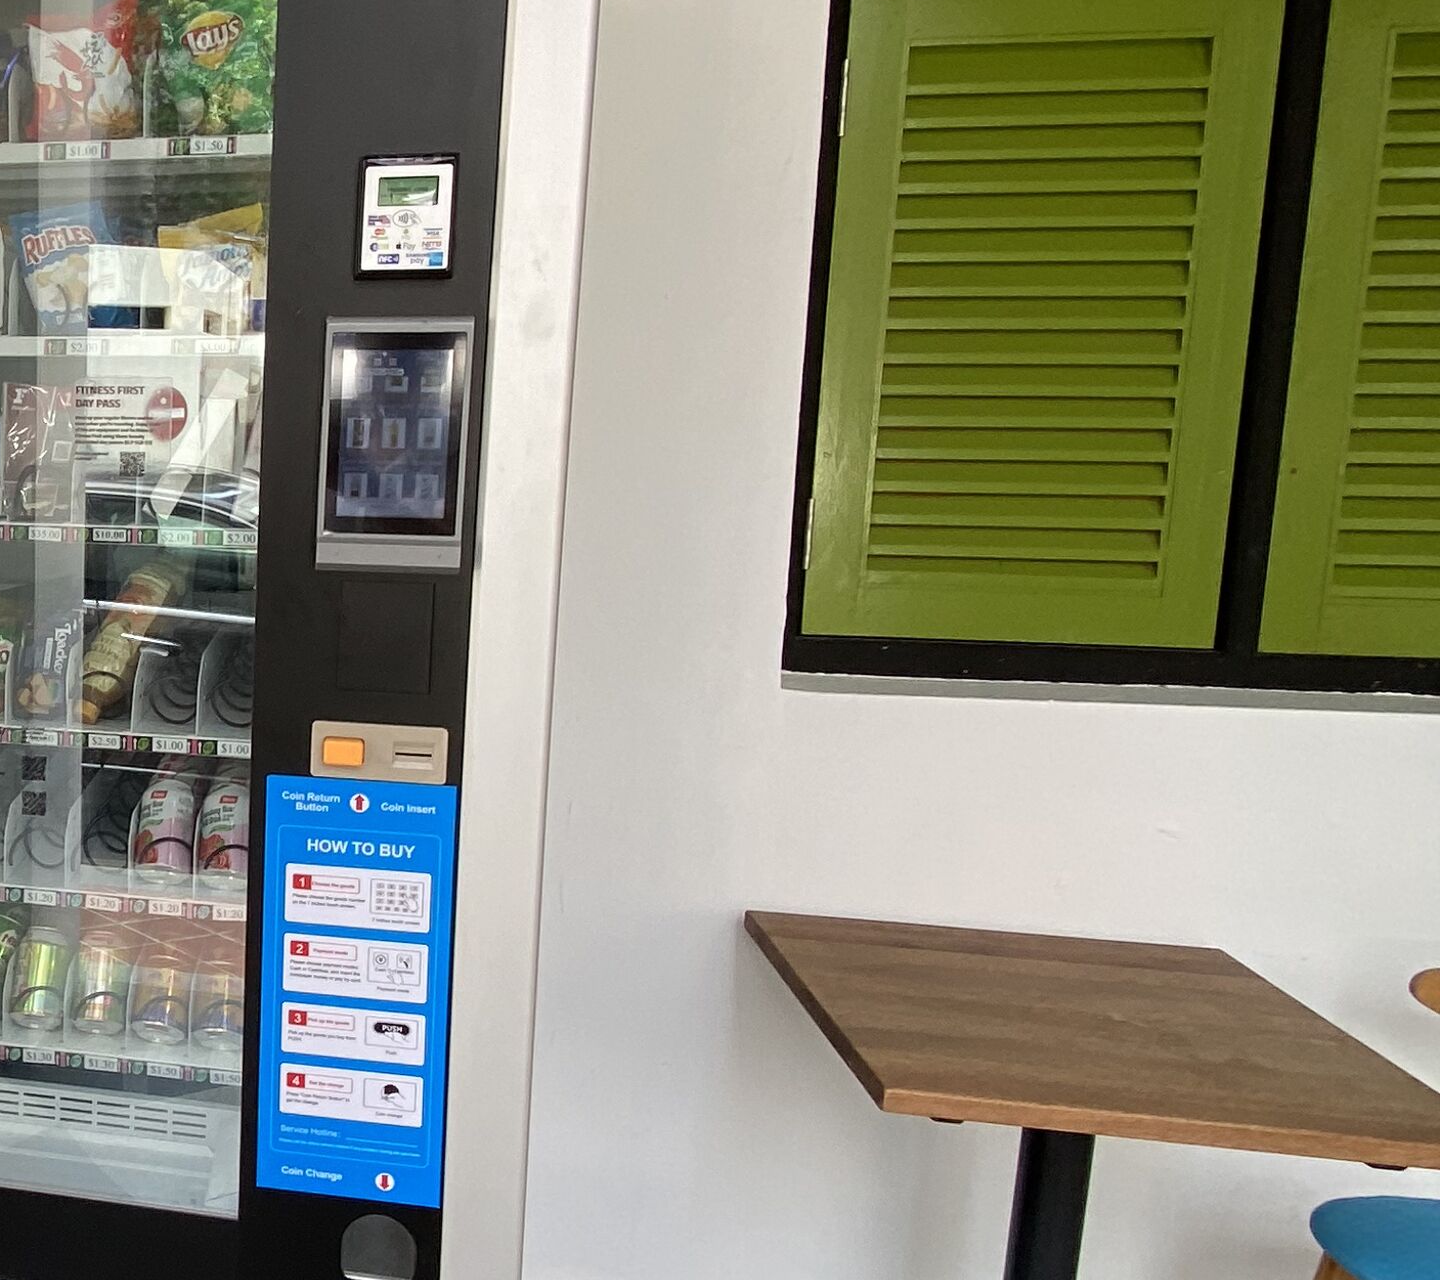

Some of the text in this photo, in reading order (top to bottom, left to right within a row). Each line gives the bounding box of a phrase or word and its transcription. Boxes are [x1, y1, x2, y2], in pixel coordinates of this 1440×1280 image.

[194, 139, 224, 151] $1.50
[23, 226, 96, 265] RUFFLES
[75, 386, 145, 395] FITNESS FIRST
[75, 399, 120, 408] DAY PASS
[161, 532, 190, 543] $2.00
[227, 534, 256, 544] $2.00
[91, 737, 117, 747] $2.50
[157, 740, 183, 750] $1.00
[221, 744, 249, 754] $1.00
[281, 791, 341, 803] Coin Return
[295, 801, 329, 812] Button
[381, 802, 436, 815] Coin Insert
[306, 838, 416, 859] HOW TO BUY
[298, 877, 306, 887] 1
[28, 892, 54, 903] $1.20
[89, 898, 116, 909] $1.20
[152, 903, 179, 913] $1.20
[216, 908, 244, 918] $1.20
[295, 944, 303, 954] 2
[294, 1013, 302, 1023] 3
[291, 1075, 300, 1086] 4
[280, 1124, 309, 1134] Service
[280, 1165, 343, 1182] Coin Change
